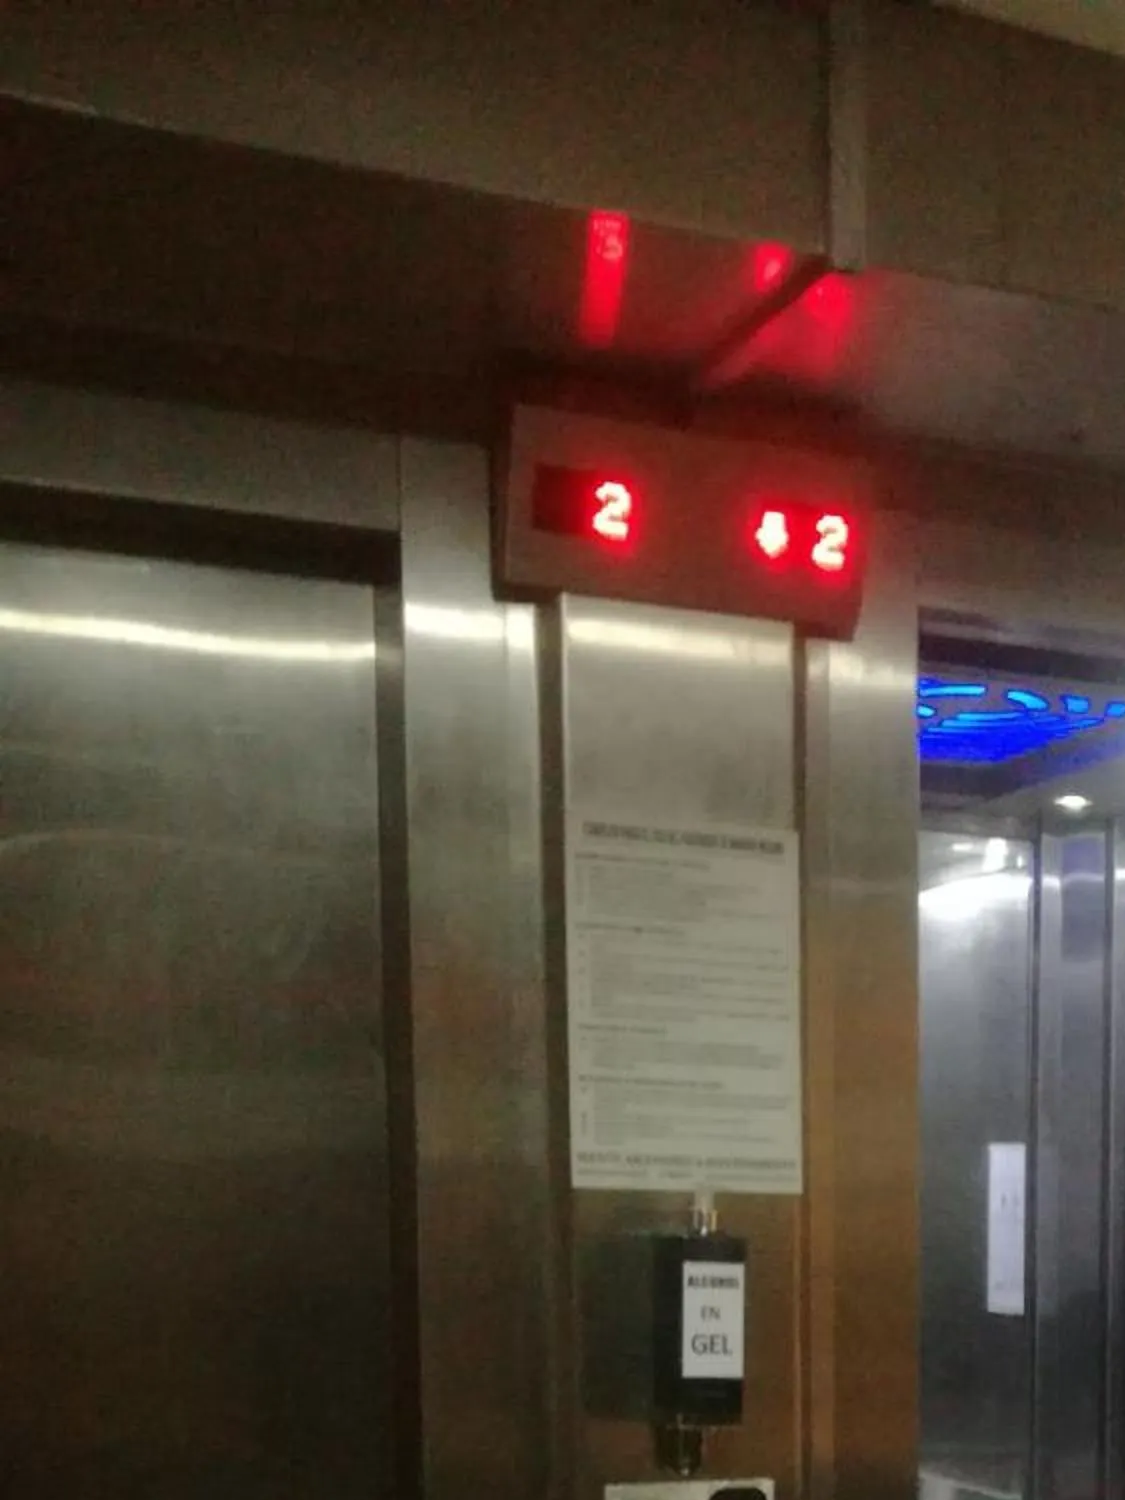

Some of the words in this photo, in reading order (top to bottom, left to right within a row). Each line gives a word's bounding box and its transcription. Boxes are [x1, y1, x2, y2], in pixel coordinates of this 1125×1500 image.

[592, 481, 632, 540] 2
[811, 515, 849, 570] 2
[691, 1333, 733, 1356] GEL
